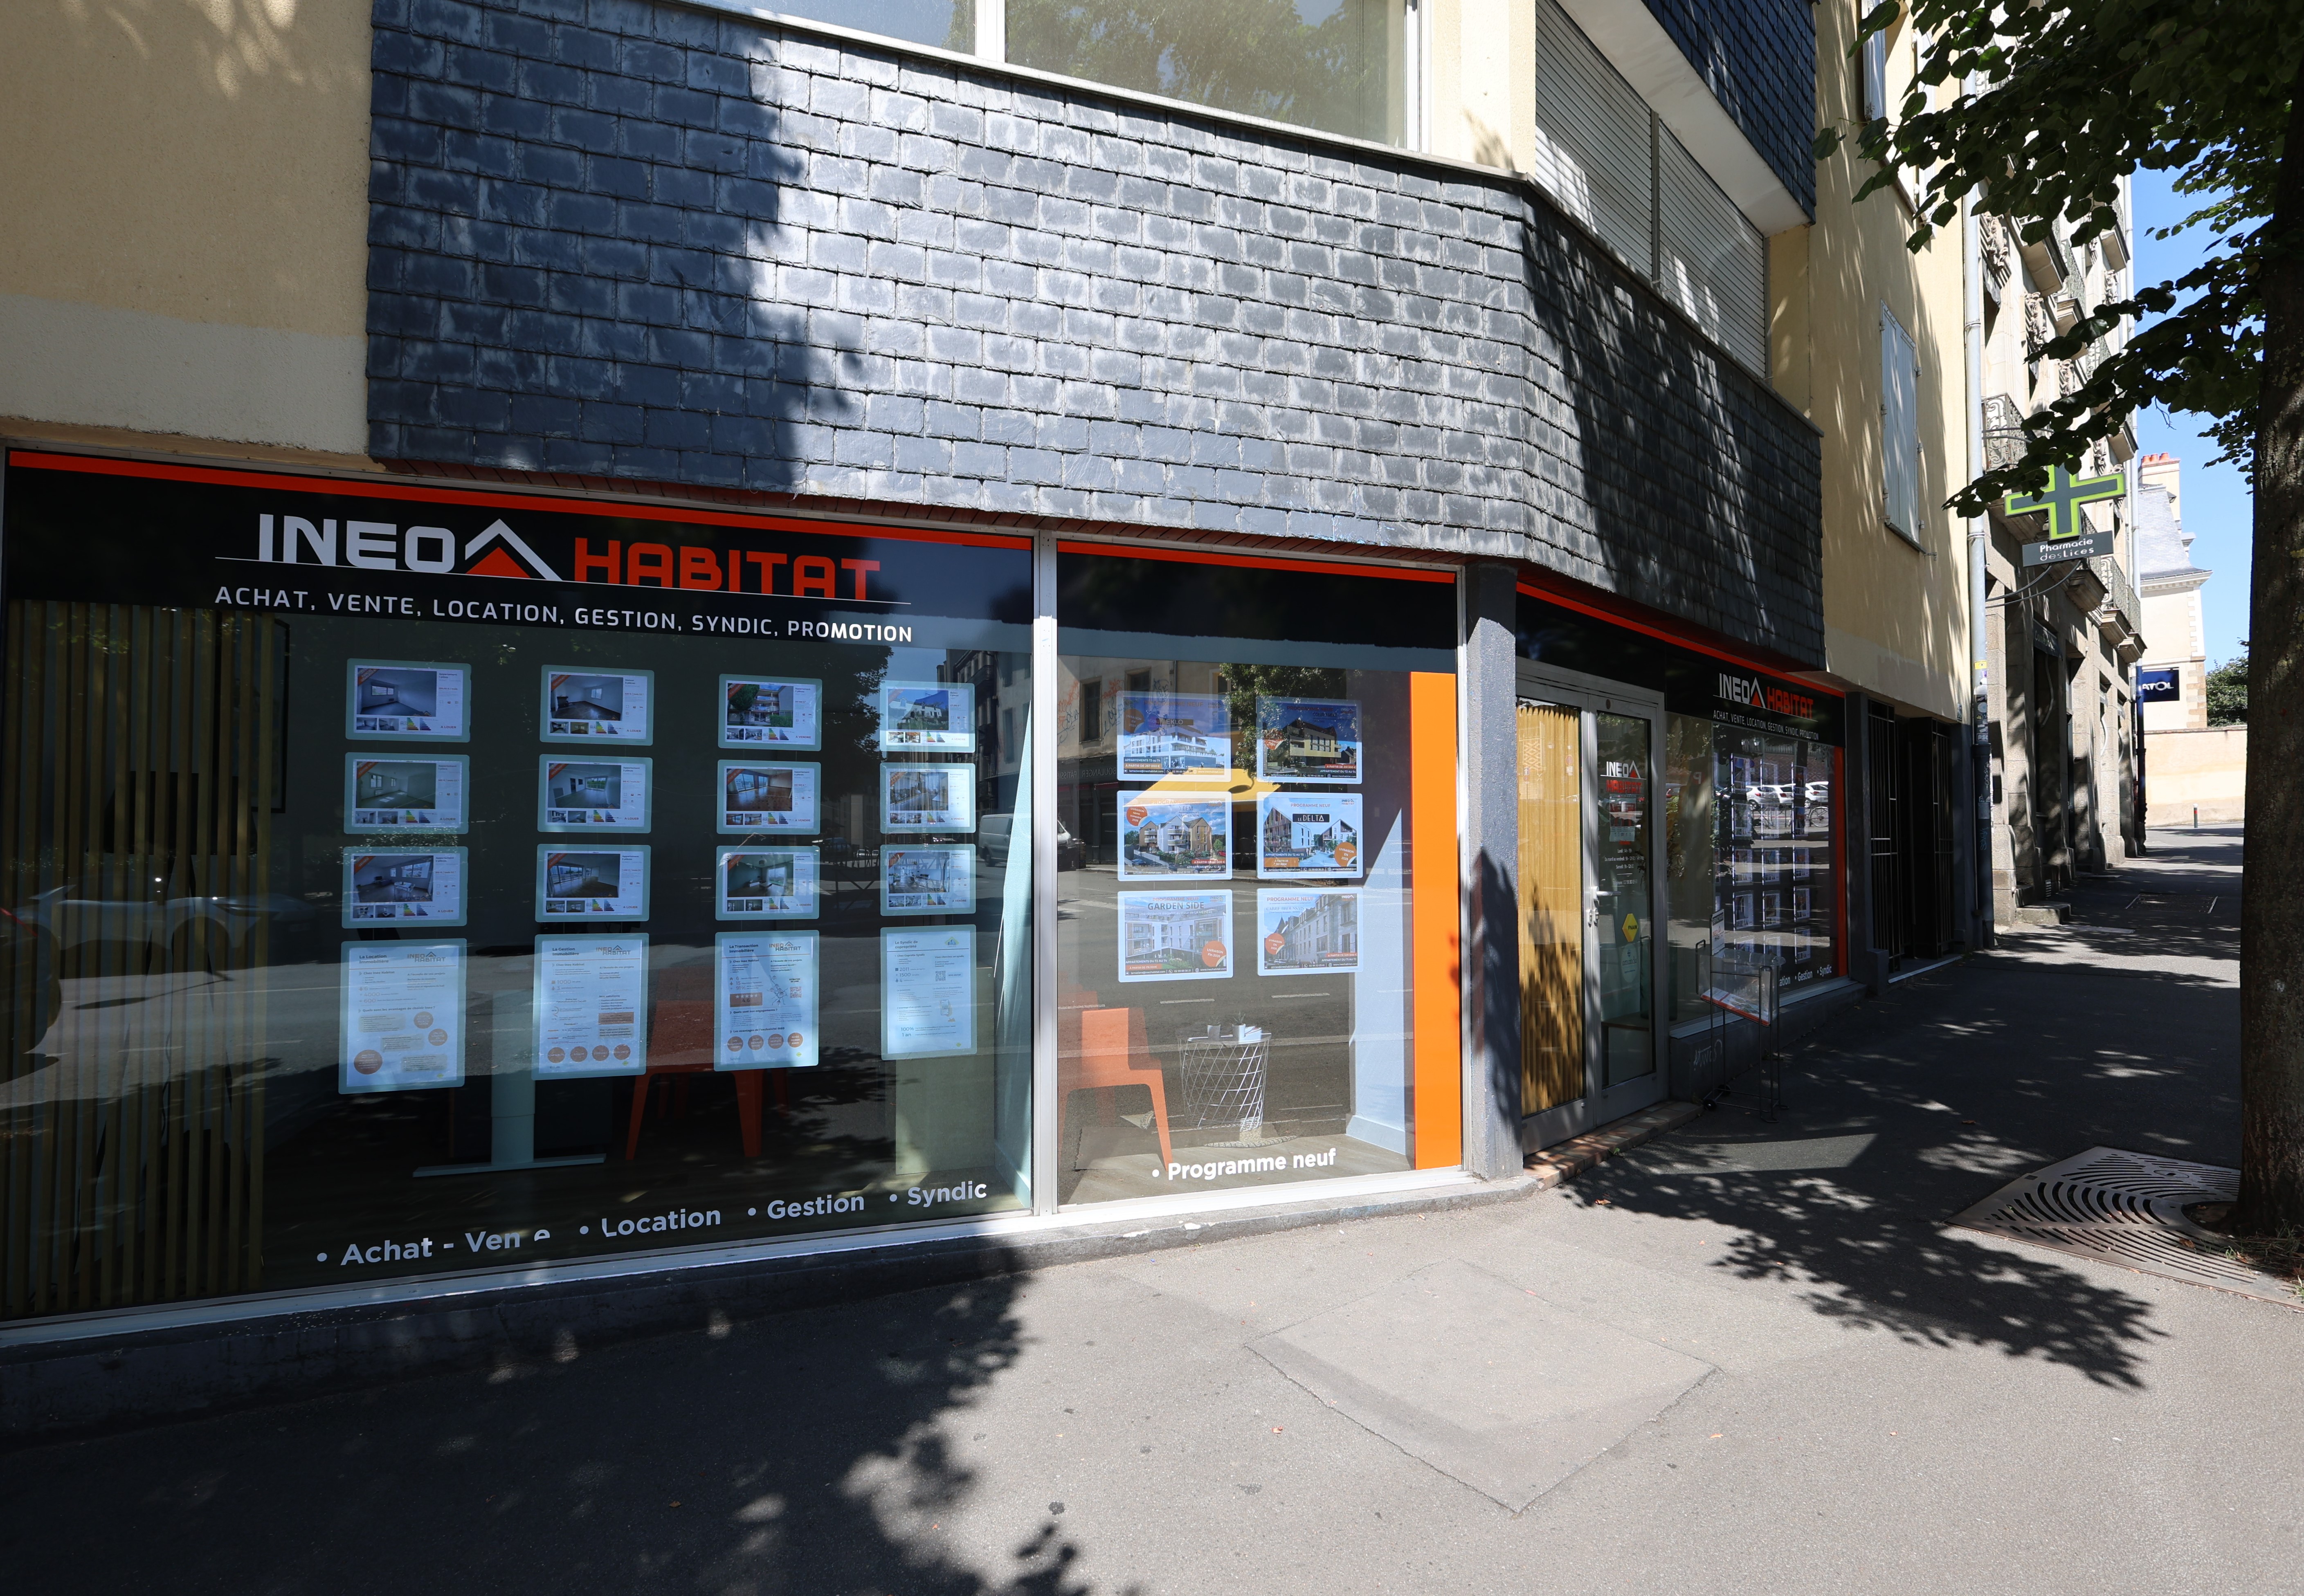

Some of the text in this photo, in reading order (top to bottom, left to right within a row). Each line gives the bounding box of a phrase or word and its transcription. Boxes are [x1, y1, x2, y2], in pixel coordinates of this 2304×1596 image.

[258, 513, 881, 601] INEO HABITAT
[2039, 538, 2093, 553] Pharmacie
[215, 586, 912, 642] ACHAT, VENTE, LOCATION, GESTION, SYNDIC, PROMOTION
[1719, 673, 1814, 719] INEO HABITAT
[2142, 681, 2174, 691] ATOL
[1713, 710, 1819, 741] ACHAT, VENTE, LOCATION, GESTION, SYNDIC, PROMOTION
[1606, 761, 1629, 777] INEO
[1606, 779, 1643, 794] HABITAT
[1148, 902, 1183, 910] GARDEN
[1798, 970, 1813, 982] Gestion
[1819, 964, 1832, 977] Syndic
[1168, 1148, 1336, 1181] Programme neuf
[340, 1237, 433, 1266] Achat
[465, 1229, 551, 1253] Vene
[602, 1210, 721, 1238] Location
[767, 1193, 865, 1219] Gestion
[907, 1181, 987, 1208] Syndic
